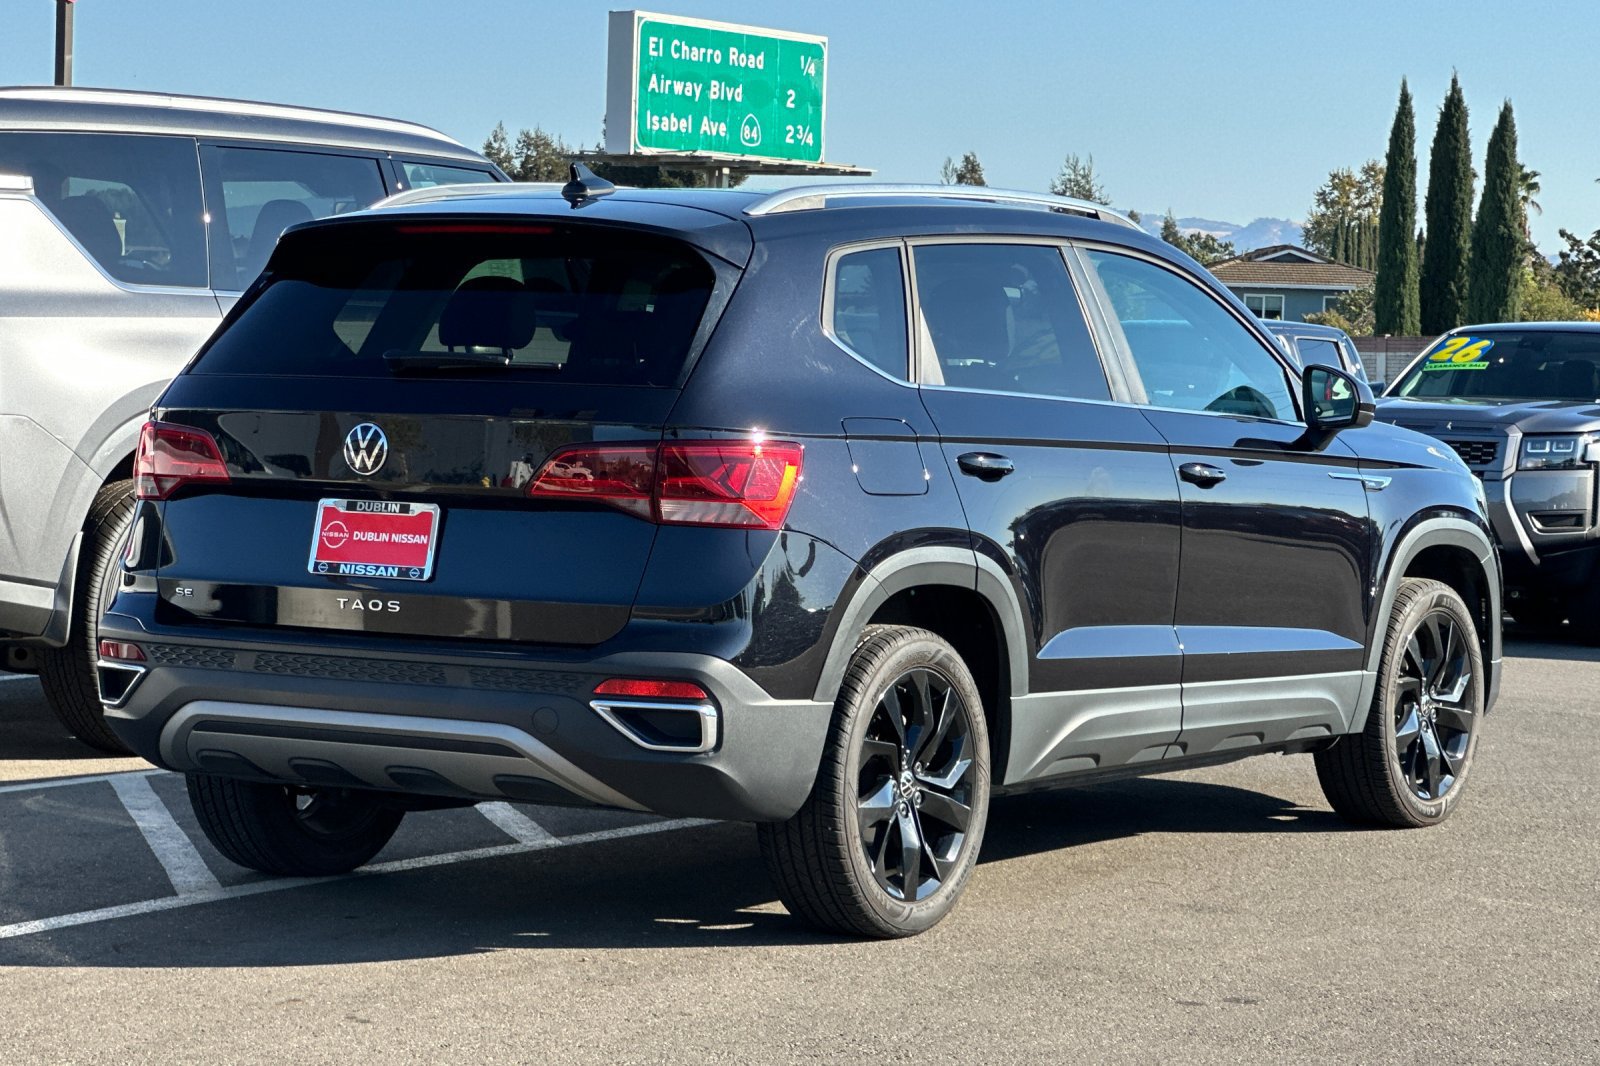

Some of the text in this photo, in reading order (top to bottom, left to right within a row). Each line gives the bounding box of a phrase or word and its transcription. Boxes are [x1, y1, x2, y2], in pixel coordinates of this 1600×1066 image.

[648, 36, 664, 57] El
[670, 39, 722, 65] Charro
[729, 47, 765, 70] Road
[647, 73, 796, 109] Airway Blvd 2
[646, 110, 692, 134] Isabel
[699, 116, 727, 137] Ave
[743, 124, 758, 141] 84
[1429, 336, 1491, 363] 26
[345, 424, 387, 474] VW
[356, 501, 401, 513] DUBLIN
[321, 531, 350, 539] NISSAN
[353, 530, 428, 545] DUBLIN NISSAN
[339, 563, 399, 578] NISSAN
[175, 586, 194, 598] SE
[336, 597, 401, 613] TAOS
